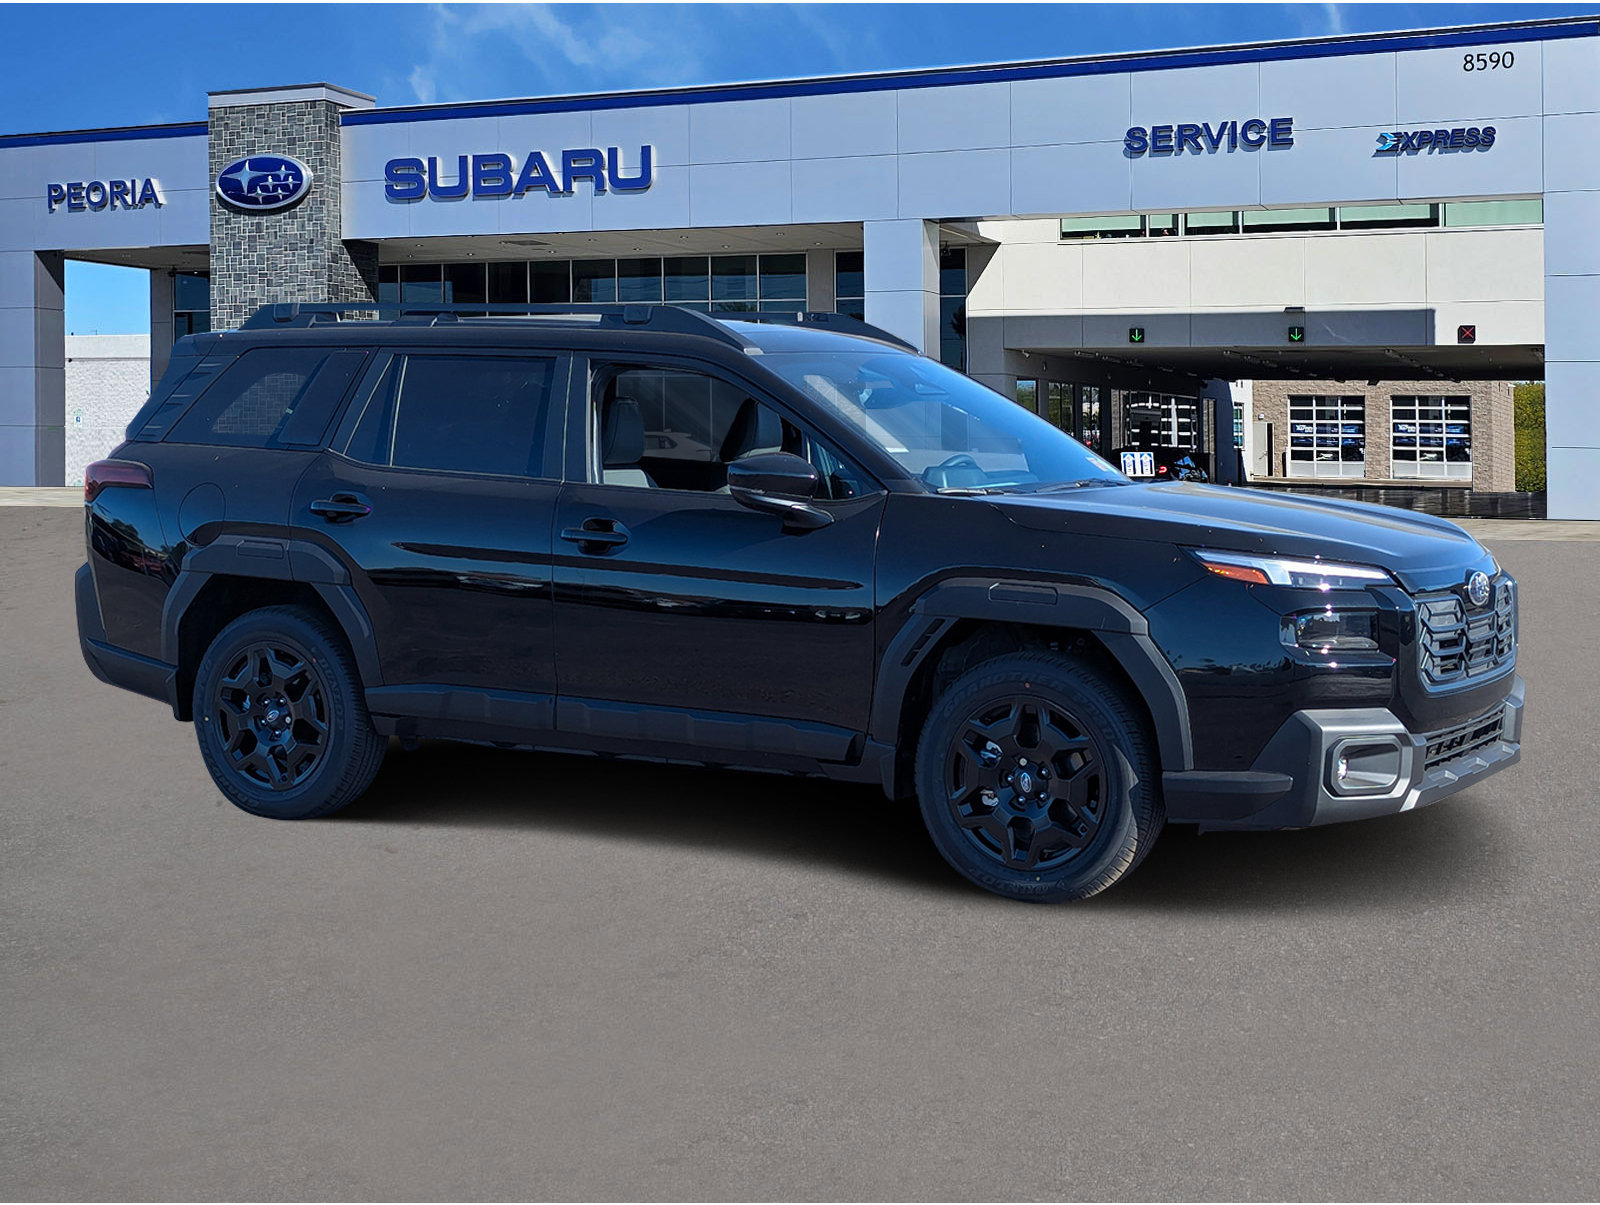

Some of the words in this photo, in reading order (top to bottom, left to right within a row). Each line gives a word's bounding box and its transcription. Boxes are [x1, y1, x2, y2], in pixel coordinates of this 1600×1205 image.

[1463, 51, 1514, 71] 8590
[1125, 118, 1294, 152] SERVICE
[1376, 127, 1496, 150] EXPRESS
[385, 145, 652, 198] SUBARU
[48, 178, 160, 209] PEORIA
